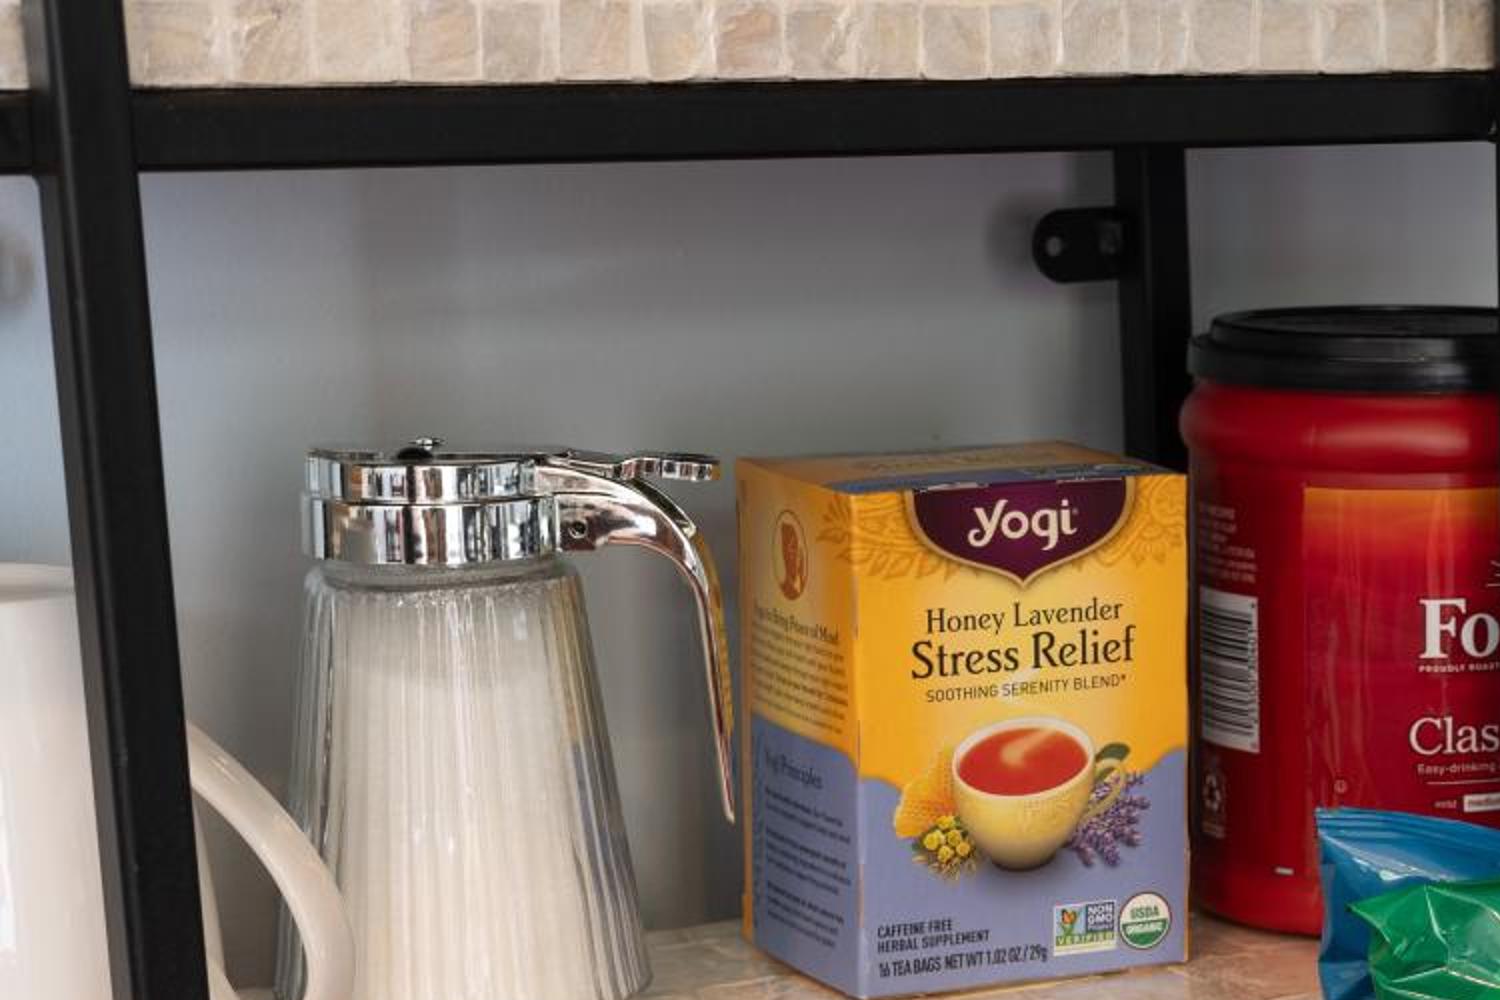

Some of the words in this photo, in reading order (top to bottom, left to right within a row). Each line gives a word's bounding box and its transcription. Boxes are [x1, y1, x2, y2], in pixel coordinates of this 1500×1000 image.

[925, 607, 1005, 635] Honey
[1013, 597, 1124, 627] Lavender
[911, 639, 1020, 680] Stress
[1032, 624, 1137, 669] Relief
[927, 683, 999, 703] SOOTHING
[1002, 678, 1069, 698] SERENITY
[877, 920, 925, 939] CAFFEINE
[928, 918, 953, 935] FREE
[877, 937, 919, 954] HERBAL
[921, 929, 991, 949] SUPPLEMENT
[891, 957, 914, 977] TEA
[913, 955, 942, 974] BAGS
[944, 953, 965, 971] NET
[966, 951, 984, 969] WT
